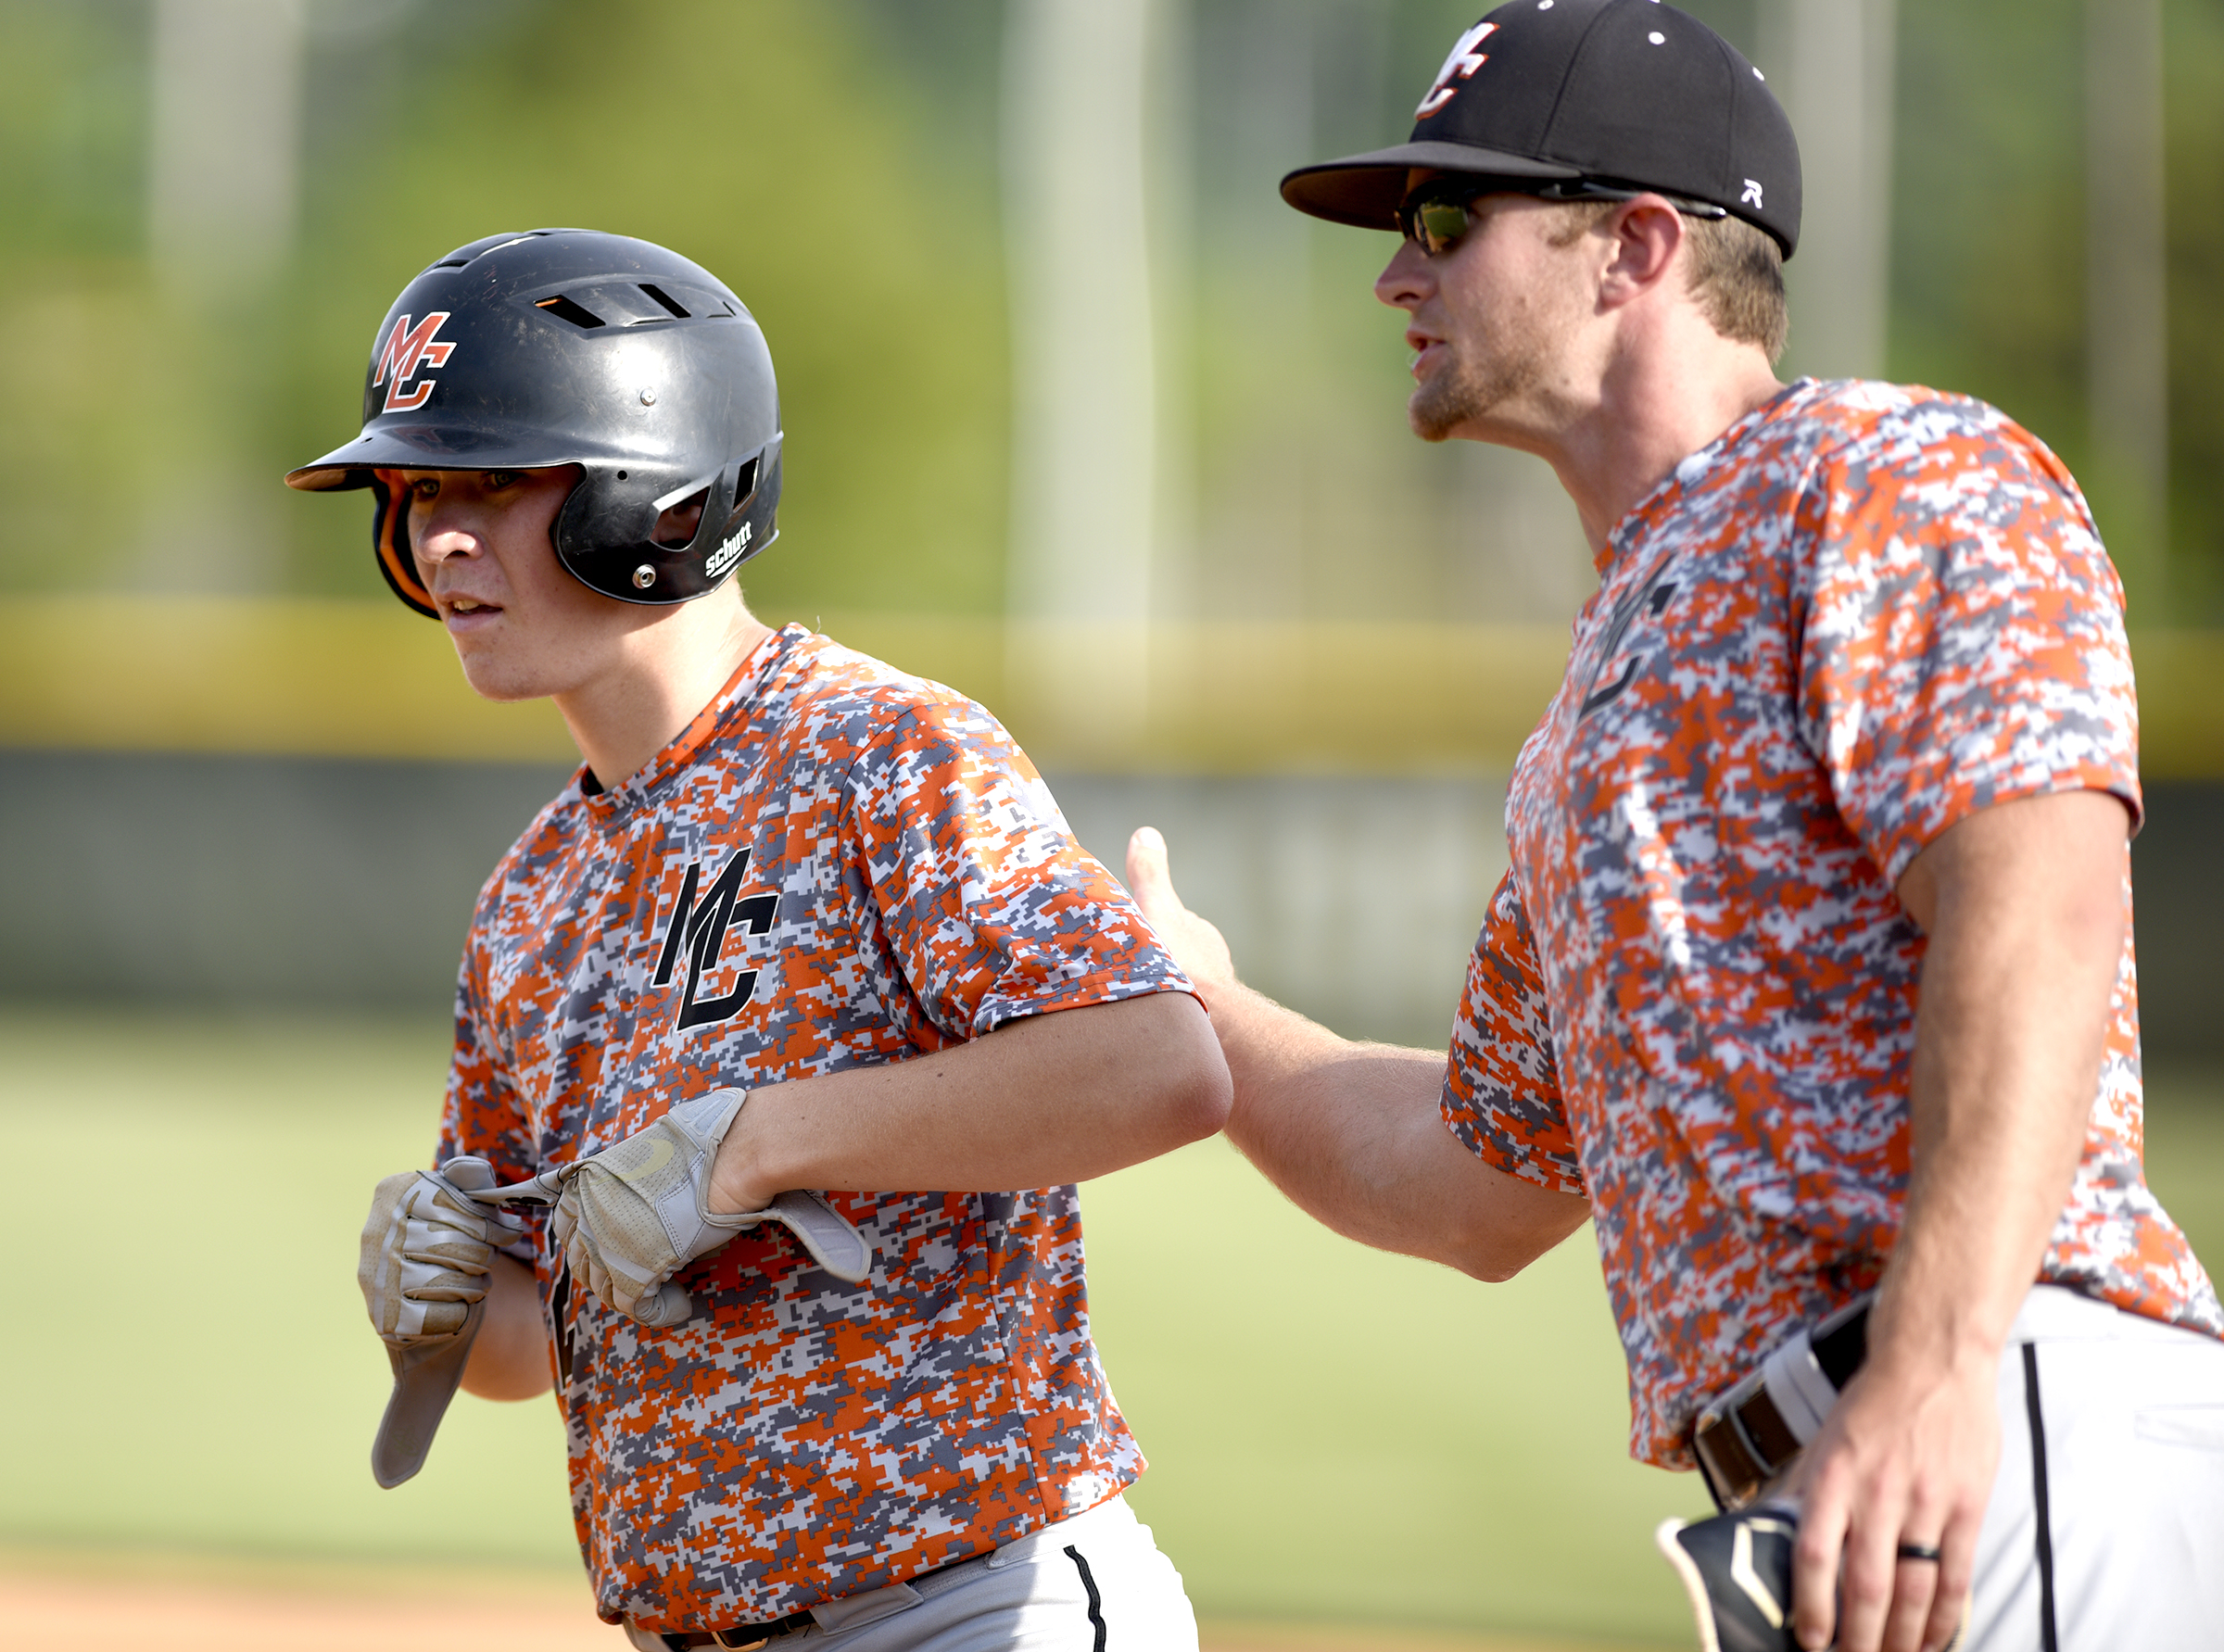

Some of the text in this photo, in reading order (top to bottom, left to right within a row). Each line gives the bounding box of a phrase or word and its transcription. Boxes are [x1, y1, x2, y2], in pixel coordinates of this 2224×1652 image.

[1741, 178, 1763, 209] R
[373, 311, 458, 414] MC
[705, 521, 752, 577] schutt
[650, 847, 780, 1032] MC
